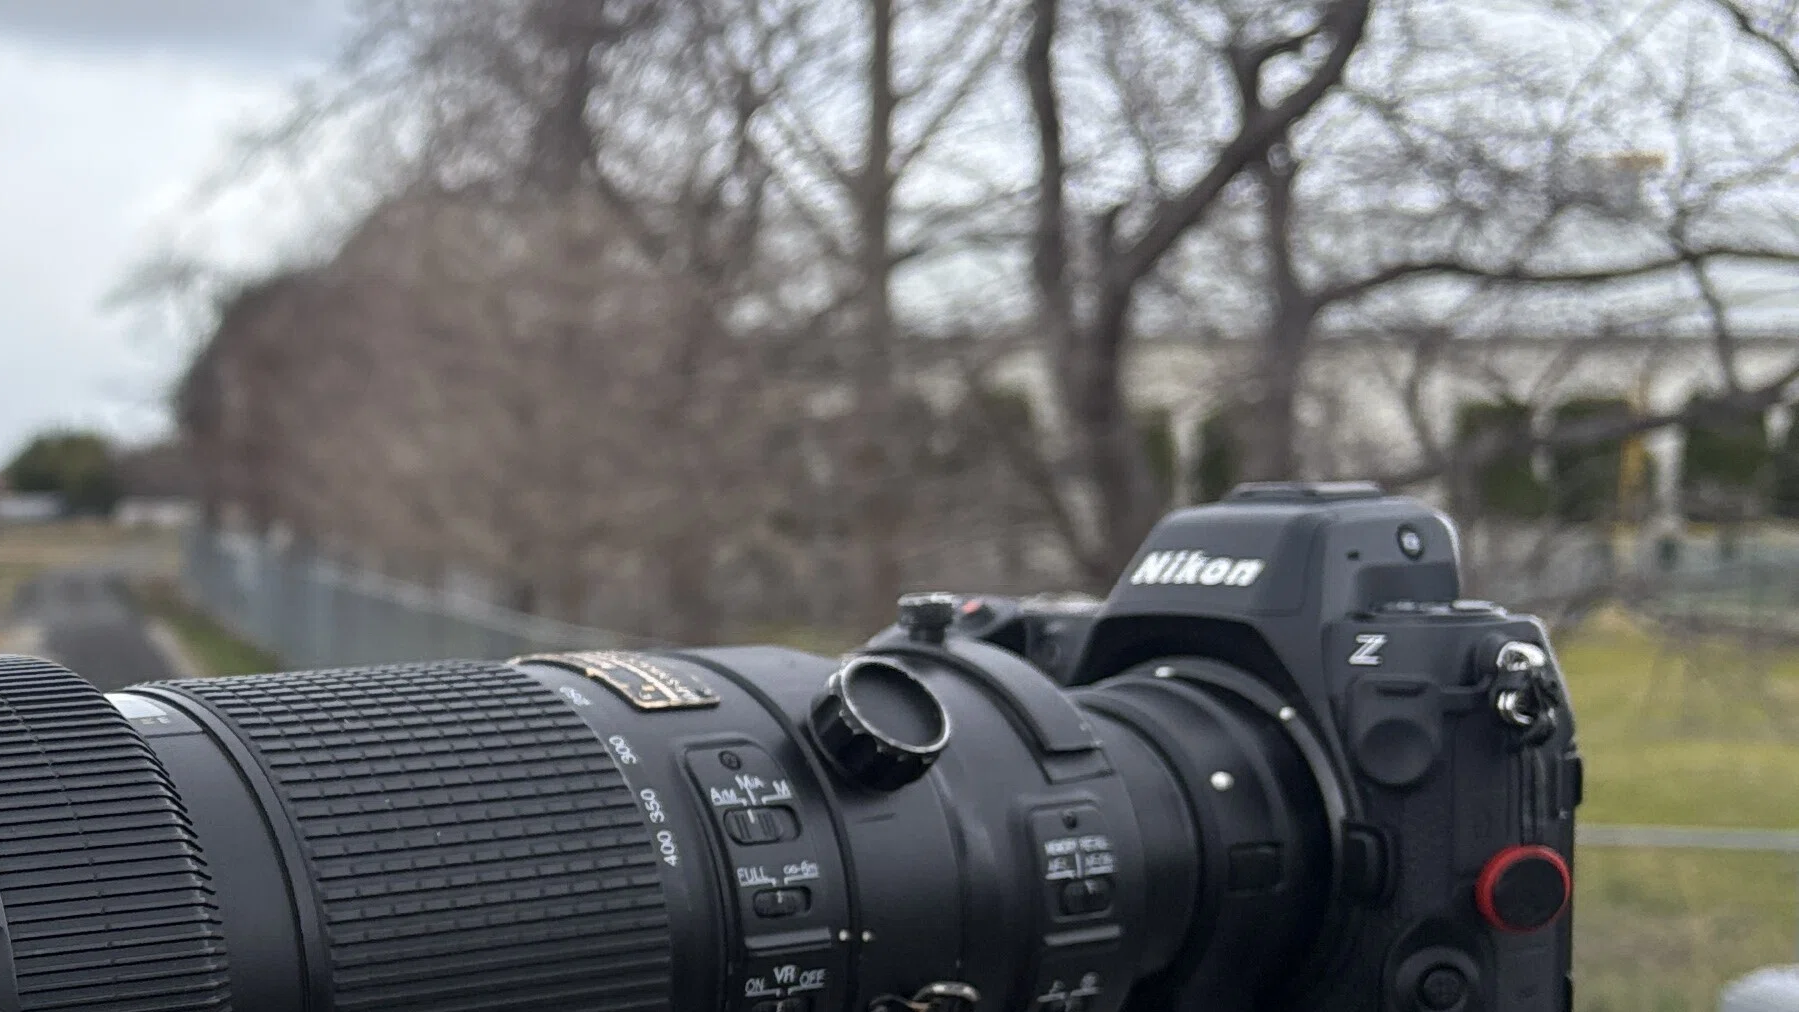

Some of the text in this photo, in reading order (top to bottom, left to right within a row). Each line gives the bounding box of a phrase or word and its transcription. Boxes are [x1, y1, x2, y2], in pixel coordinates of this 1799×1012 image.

[1131, 549, 1266, 587] Nikon
[1348, 633, 1387, 666] Z
[608, 735, 638, 765] 300
[772, 780, 793, 797] M
[640, 788, 665, 824] 350
[656, 830, 680, 867] 400
[736, 866, 768, 883] FULL
[744, 964, 827, 993] ON VR OFF
